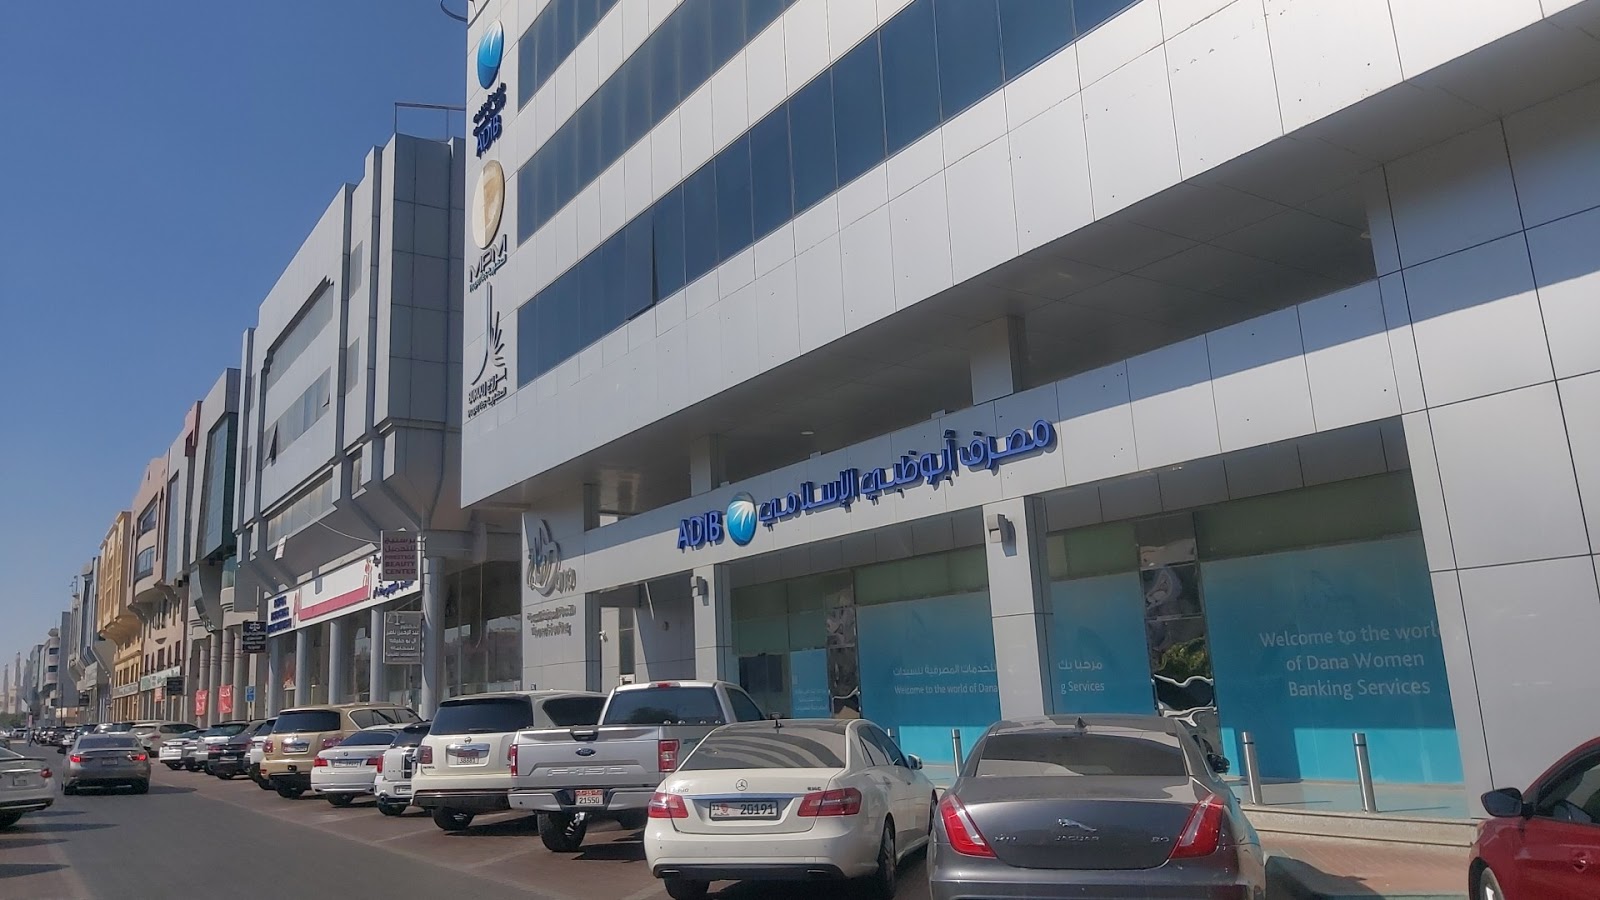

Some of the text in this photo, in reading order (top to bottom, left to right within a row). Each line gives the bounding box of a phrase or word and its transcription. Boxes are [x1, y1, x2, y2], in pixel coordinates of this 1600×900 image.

[476, 115, 502, 158] ADIB
[469, 234, 507, 282] MPM
[959, 419, 1056, 475] مصرف
[759, 467, 860, 531] الإسلامي
[676, 510, 724, 552] ADIB
[1259, 621, 1439, 648] Welcome to the worl
[961, 663, 997, 675] لخدمات
[1058, 659, 1103, 673] مرحبا بك
[1286, 653, 1424, 671] of Dana Women
[894, 683, 998, 695] Welcome to the world of Dana
[1068, 680, 1105, 692] Services
[1289, 678, 1430, 700] Banking Services
[579, 796, 600, 804] 21550
[740, 801, 775, 815] 20191
